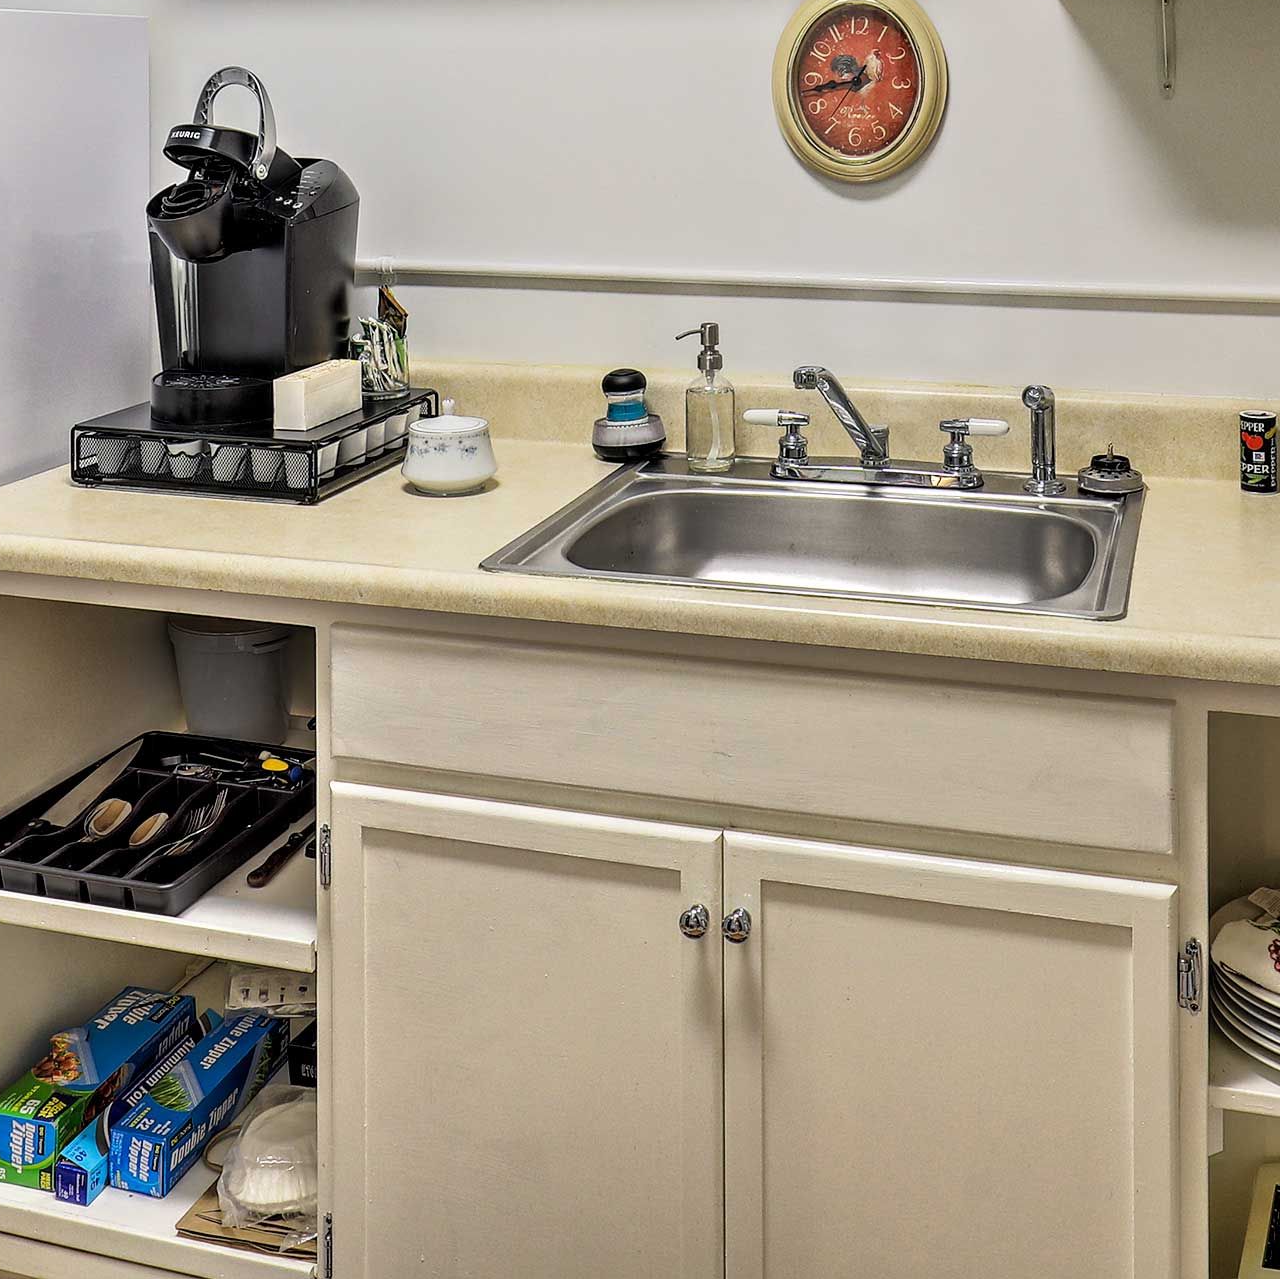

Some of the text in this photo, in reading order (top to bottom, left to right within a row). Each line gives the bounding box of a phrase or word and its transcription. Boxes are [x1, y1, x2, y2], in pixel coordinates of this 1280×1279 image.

[828, 24, 841, 42] 11
[850, 16, 869, 35] 12
[877, 25, 888, 42] 1
[810, 41, 832, 62] 10
[886, 47, 905, 64] 2
[804, 72, 823, 87] 9
[891, 76, 911, 89] 3
[808, 98, 827, 115] 8
[888, 102, 904, 119] 4
[824, 116, 841, 134] 7
[871, 120, 887, 140] 5
[171, 130, 200, 139] KEURIG
[848, 126, 862, 146] 6
[1241, 421, 1265, 432] EPPER
[145, 1038, 197, 1087] Aluminum
[200, 1037, 237, 1070] Zipper
[20, 1099, 41, 1115] 65
[37, 1096, 60, 1118] PACK
[46, 1100, 67, 1119] MEGA
[136, 1117, 155, 1130] 22
[170, 1125, 207, 1172] Double
[207, 1087, 239, 1132] Zipper
[9, 1120, 25, 1174] Zipper
[24, 1123, 36, 1164] Double
[74, 1150, 88, 1162] 40
[128, 1136, 141, 1177] Zipper
[139, 1140, 153, 1183] Double
